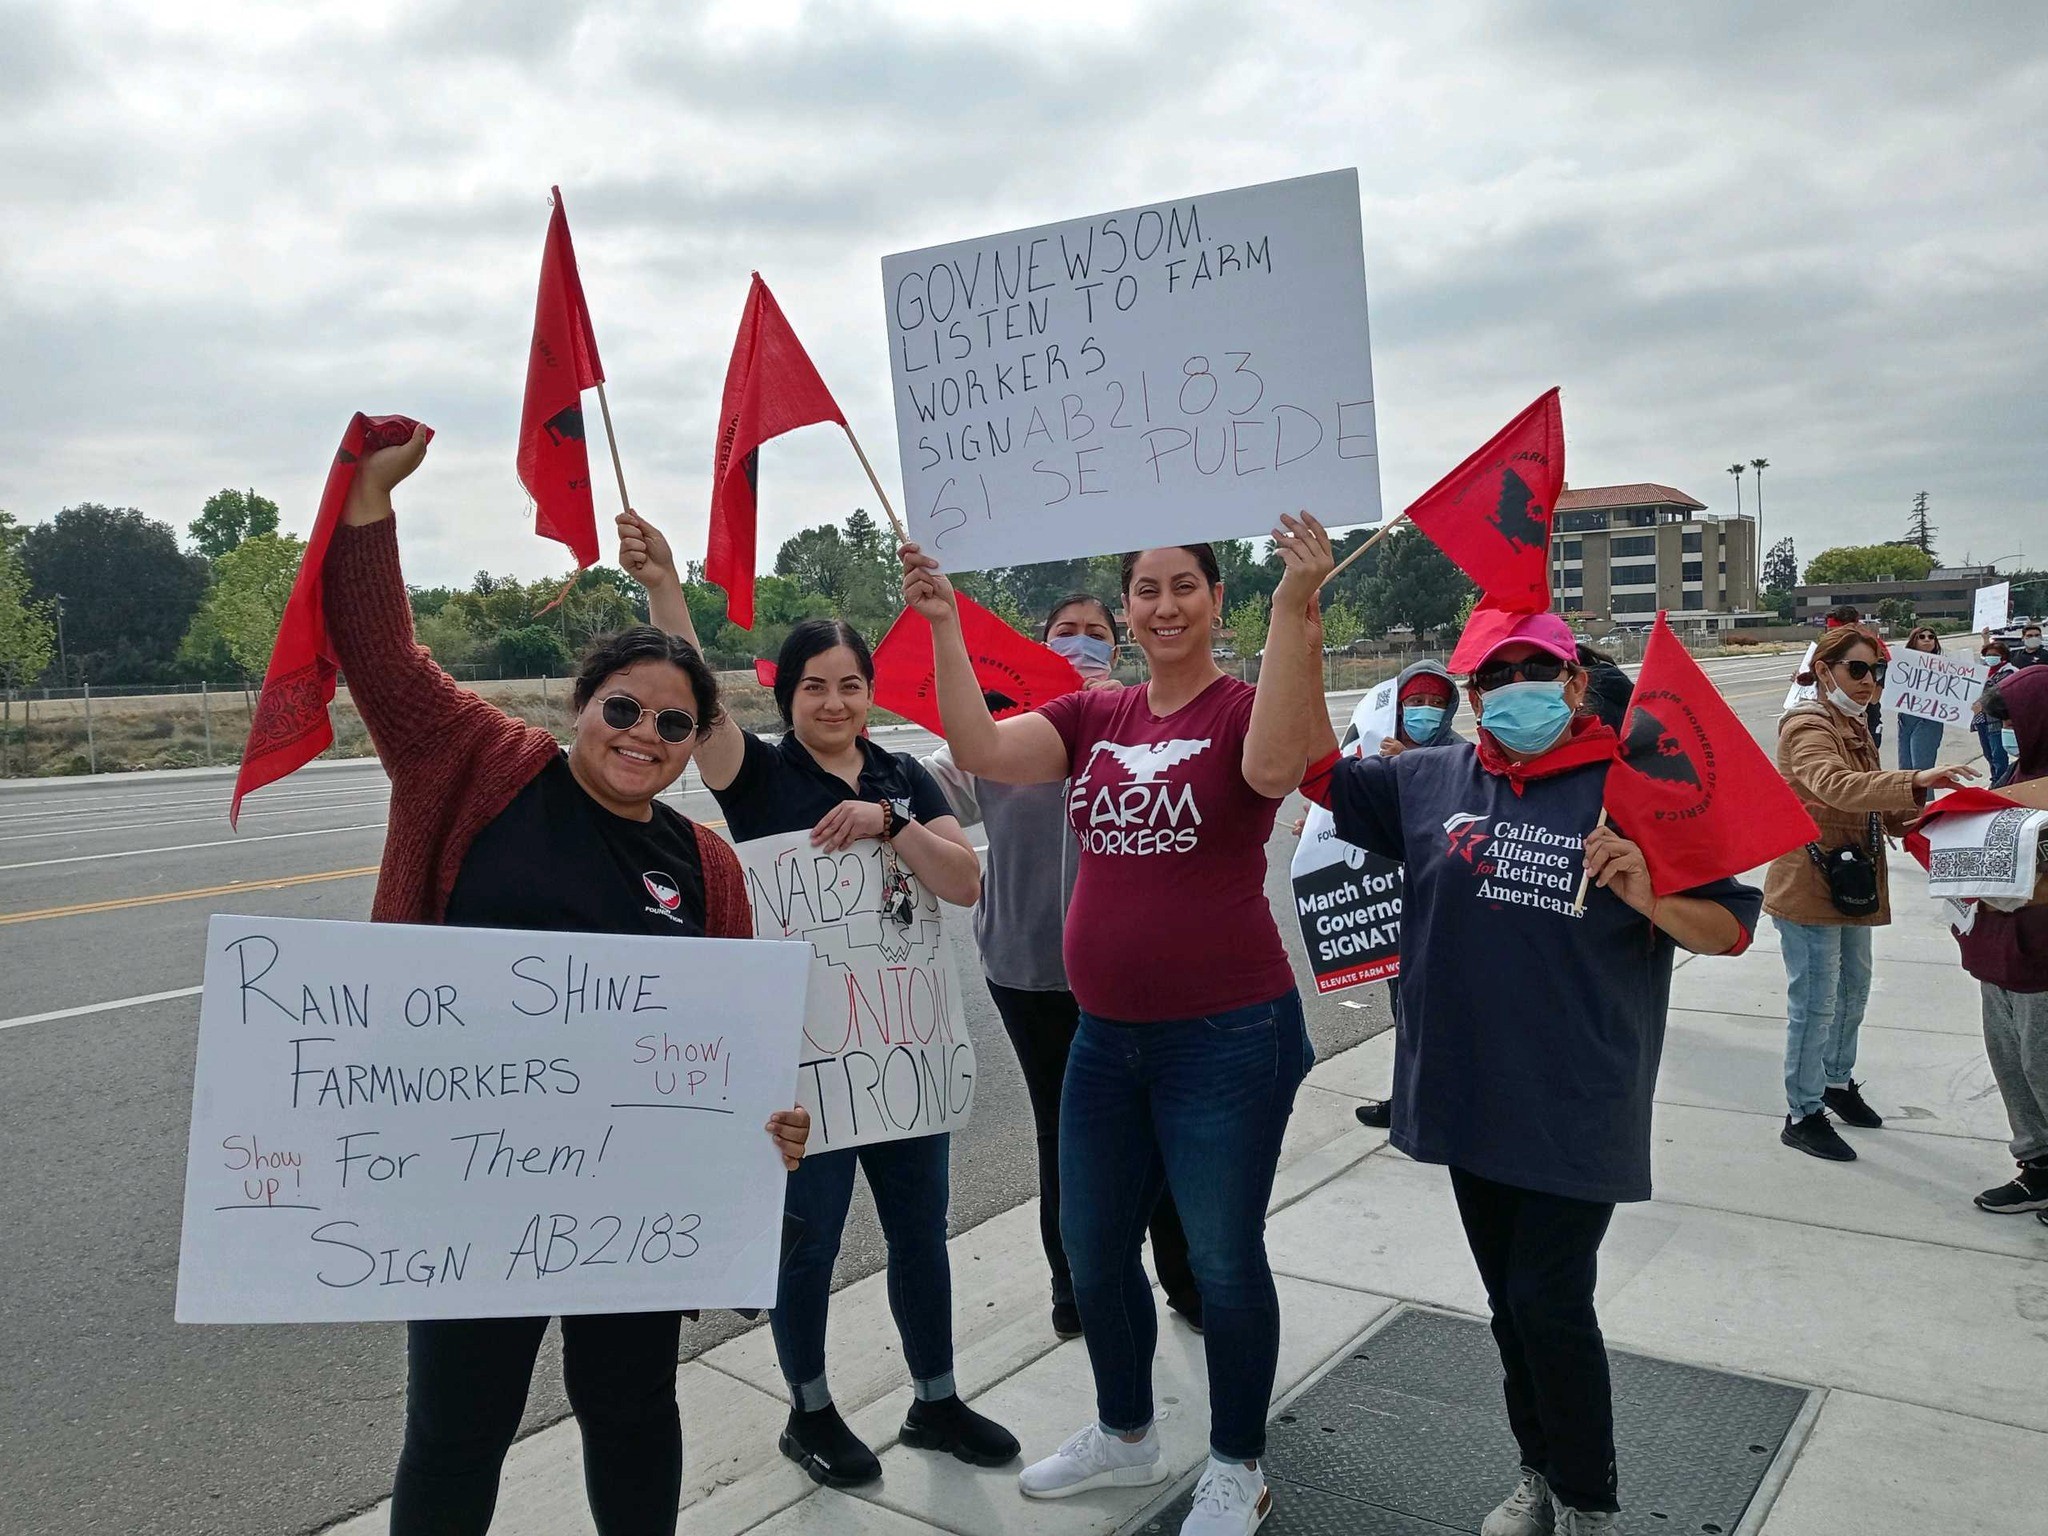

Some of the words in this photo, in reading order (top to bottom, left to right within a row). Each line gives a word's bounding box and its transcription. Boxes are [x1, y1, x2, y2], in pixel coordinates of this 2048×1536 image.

[903, 297, 1048, 373] LISTEN
[1075, 275, 1138, 323] TO
[1165, 236, 1272, 293] FARM
[909, 337, 1106, 423] WORKERS
[918, 416, 1011, 471] SIGN
[930, 474, 992, 550] SI
[1033, 447, 1109, 506] SE
[1140, 400, 1377, 484] PUEDE
[1891, 661, 1982, 701] SUPPORT
[1918, 655, 1975, 679] NEWSOM
[1638, 689, 1682, 704] FARM
[1895, 691, 1960, 722] AB2183
[1682, 705, 1717, 769] WORKERS
[1706, 771, 1717, 789] OF
[1069, 782, 1203, 828] FARM
[1654, 791, 1717, 822] AMERICA
[1075, 827, 1198, 856] WORKERS
[1317, 828, 1337, 843] FOU
[1483, 840, 1570, 870] Alliance
[1494, 821, 1583, 851] Californi
[1298, 881, 1360, 916] March
[1362, 873, 1394, 897] for
[1472, 860, 1496, 876] for
[1493, 859, 1574, 893] Retired
[1316, 898, 1402, 936] Governo
[1319, 921, 1400, 961] SIGNAT
[225, 935, 370, 1028] RAIN
[404, 984, 466, 1027] OR
[511, 954, 669, 1025] SHINE
[1320, 973, 1357, 989] ELEVATE
[1359, 966, 1384, 980] FARM
[633, 1033, 722, 1067] Show
[289, 1037, 581, 1109] FARMWORKERS
[799, 1044, 973, 1144] TRONG
[222, 1134, 302, 1171] Show
[336, 1131, 421, 1189] For
[451, 1125, 614, 1183] Them!
[310, 1220, 472, 1289] SIGN
[505, 1212, 702, 1281] AB2183
